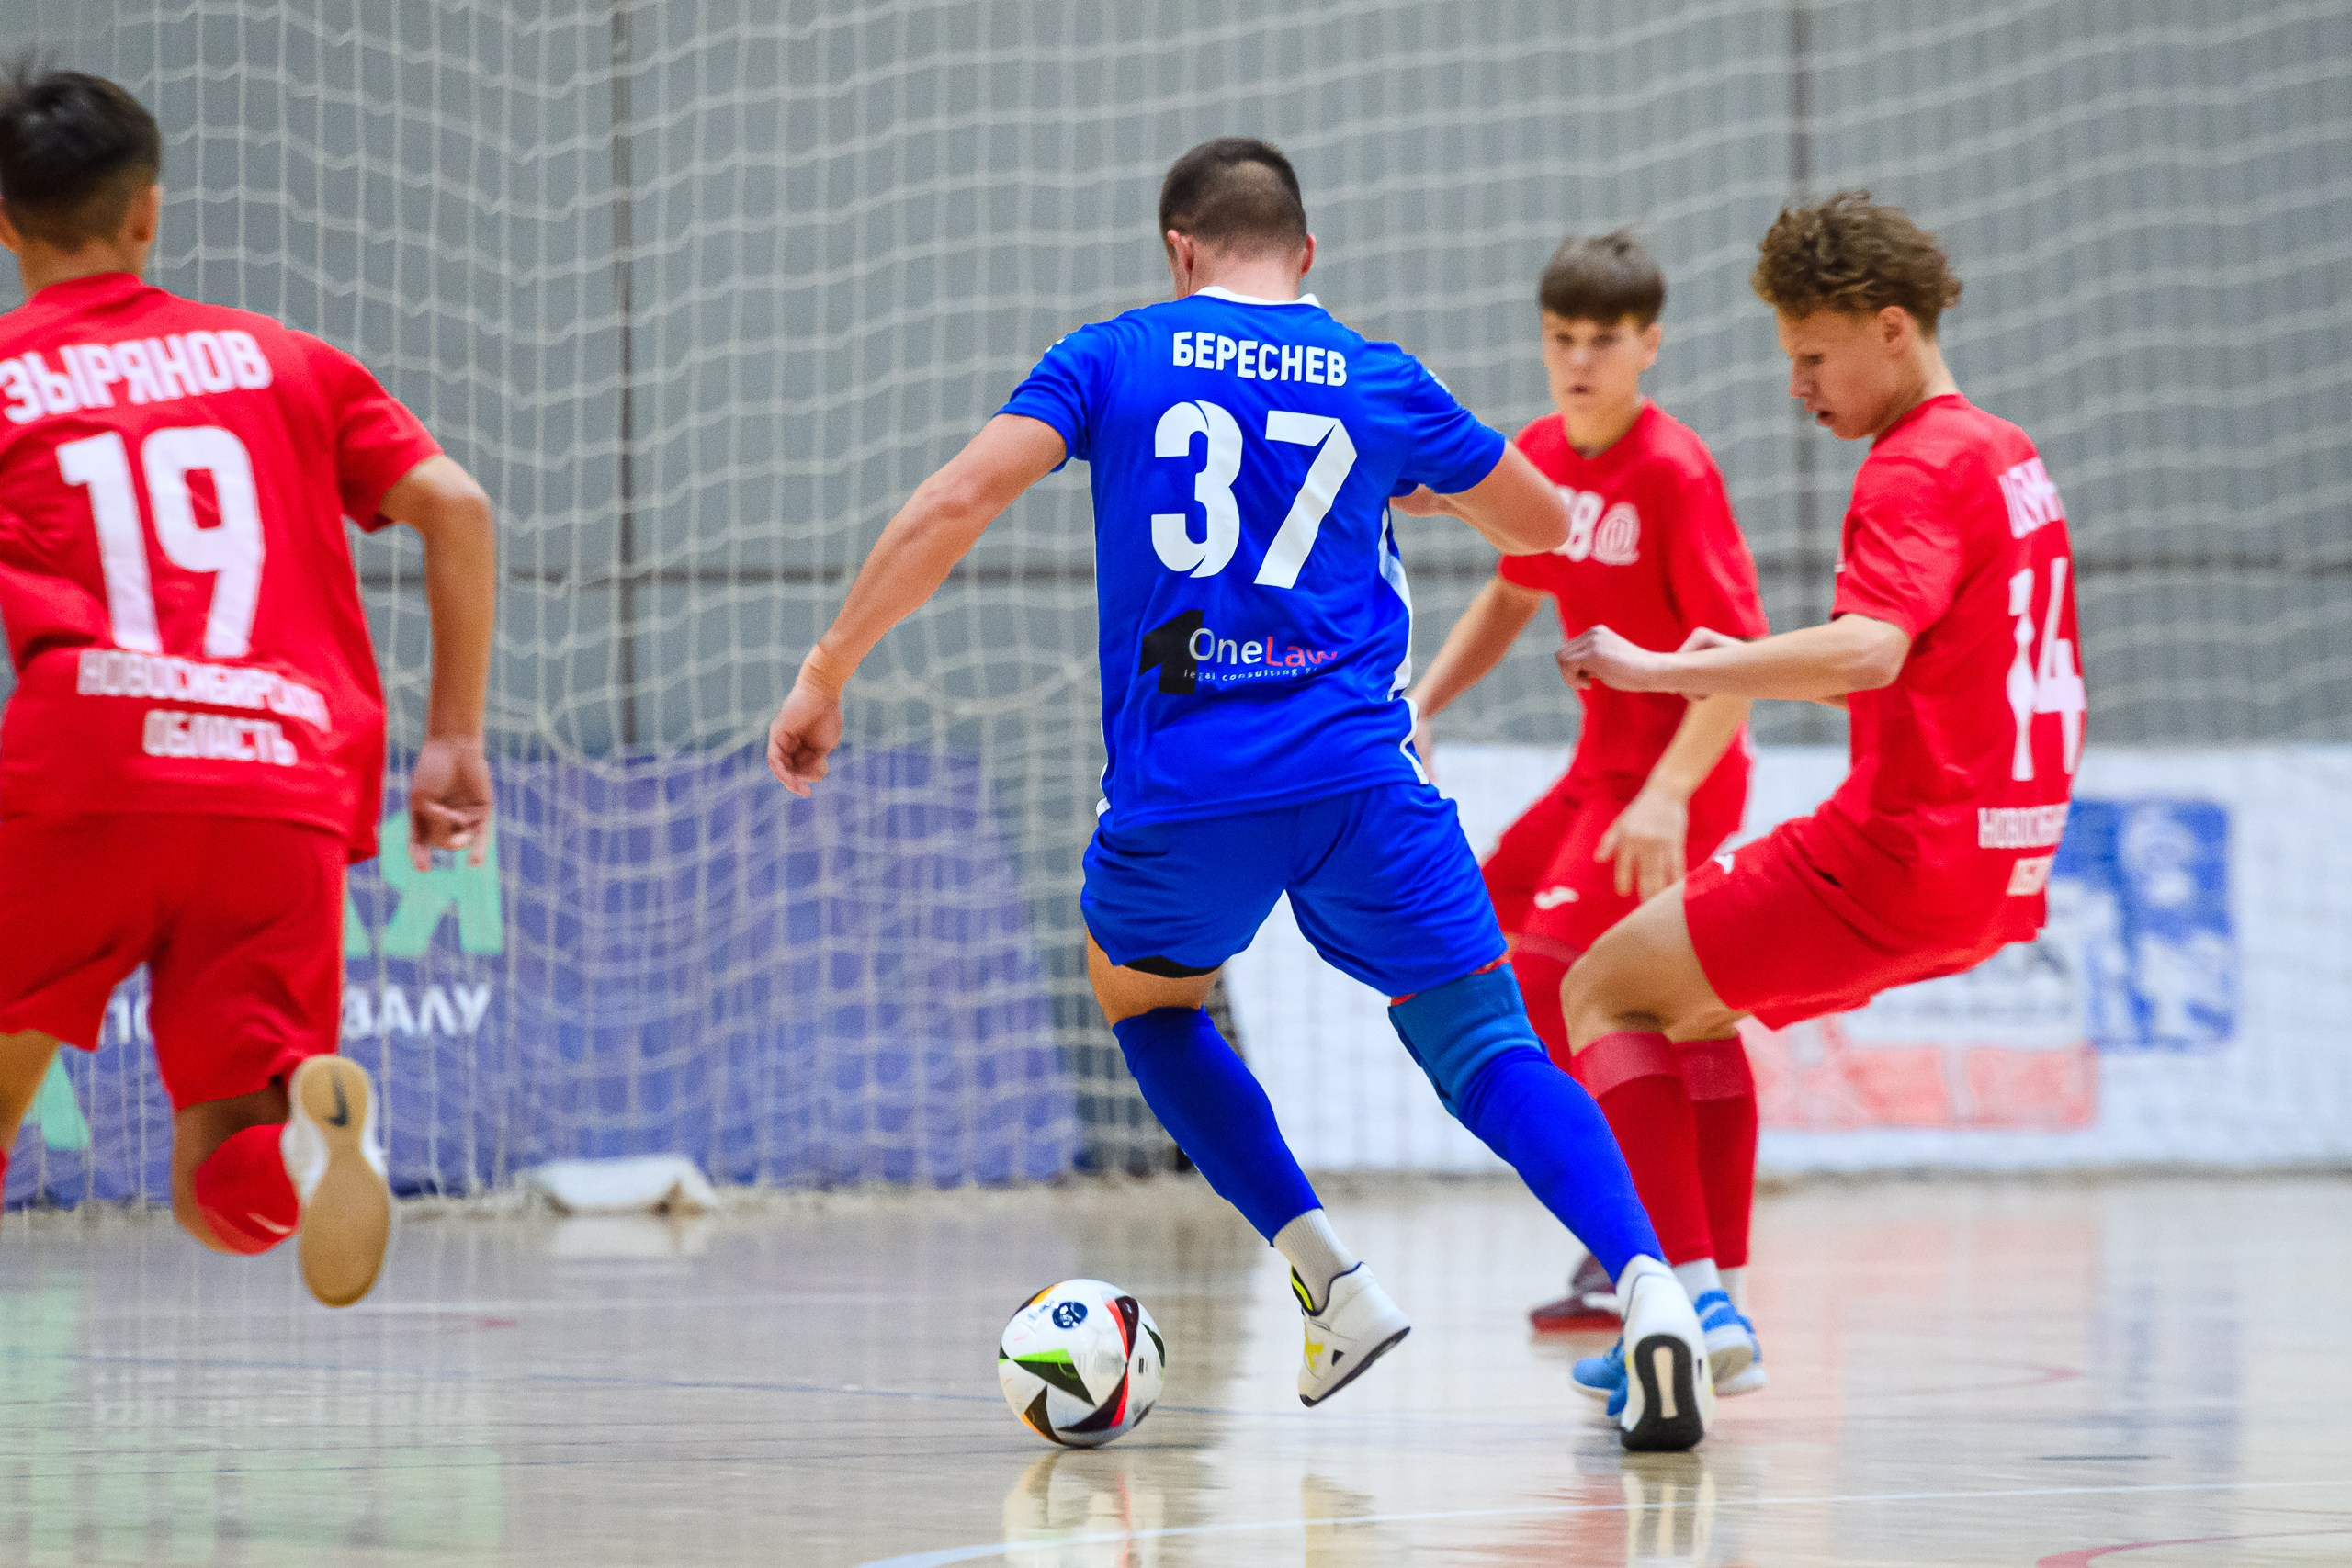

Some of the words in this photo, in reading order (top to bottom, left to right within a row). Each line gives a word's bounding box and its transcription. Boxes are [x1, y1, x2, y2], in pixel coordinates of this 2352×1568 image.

[0, 331, 274, 424] ЗЫРЯНОВ
[1172, 331, 1348, 387] БЕРЕСНЕВ
[1150, 400, 1358, 590] 37
[56, 425, 266, 659] 19
[1183, 669, 1216, 682] legal
[1222, 668, 1298, 682] consulting
[1189, 627, 1339, 667] OneLaw
[2006, 557, 2088, 782] 14
